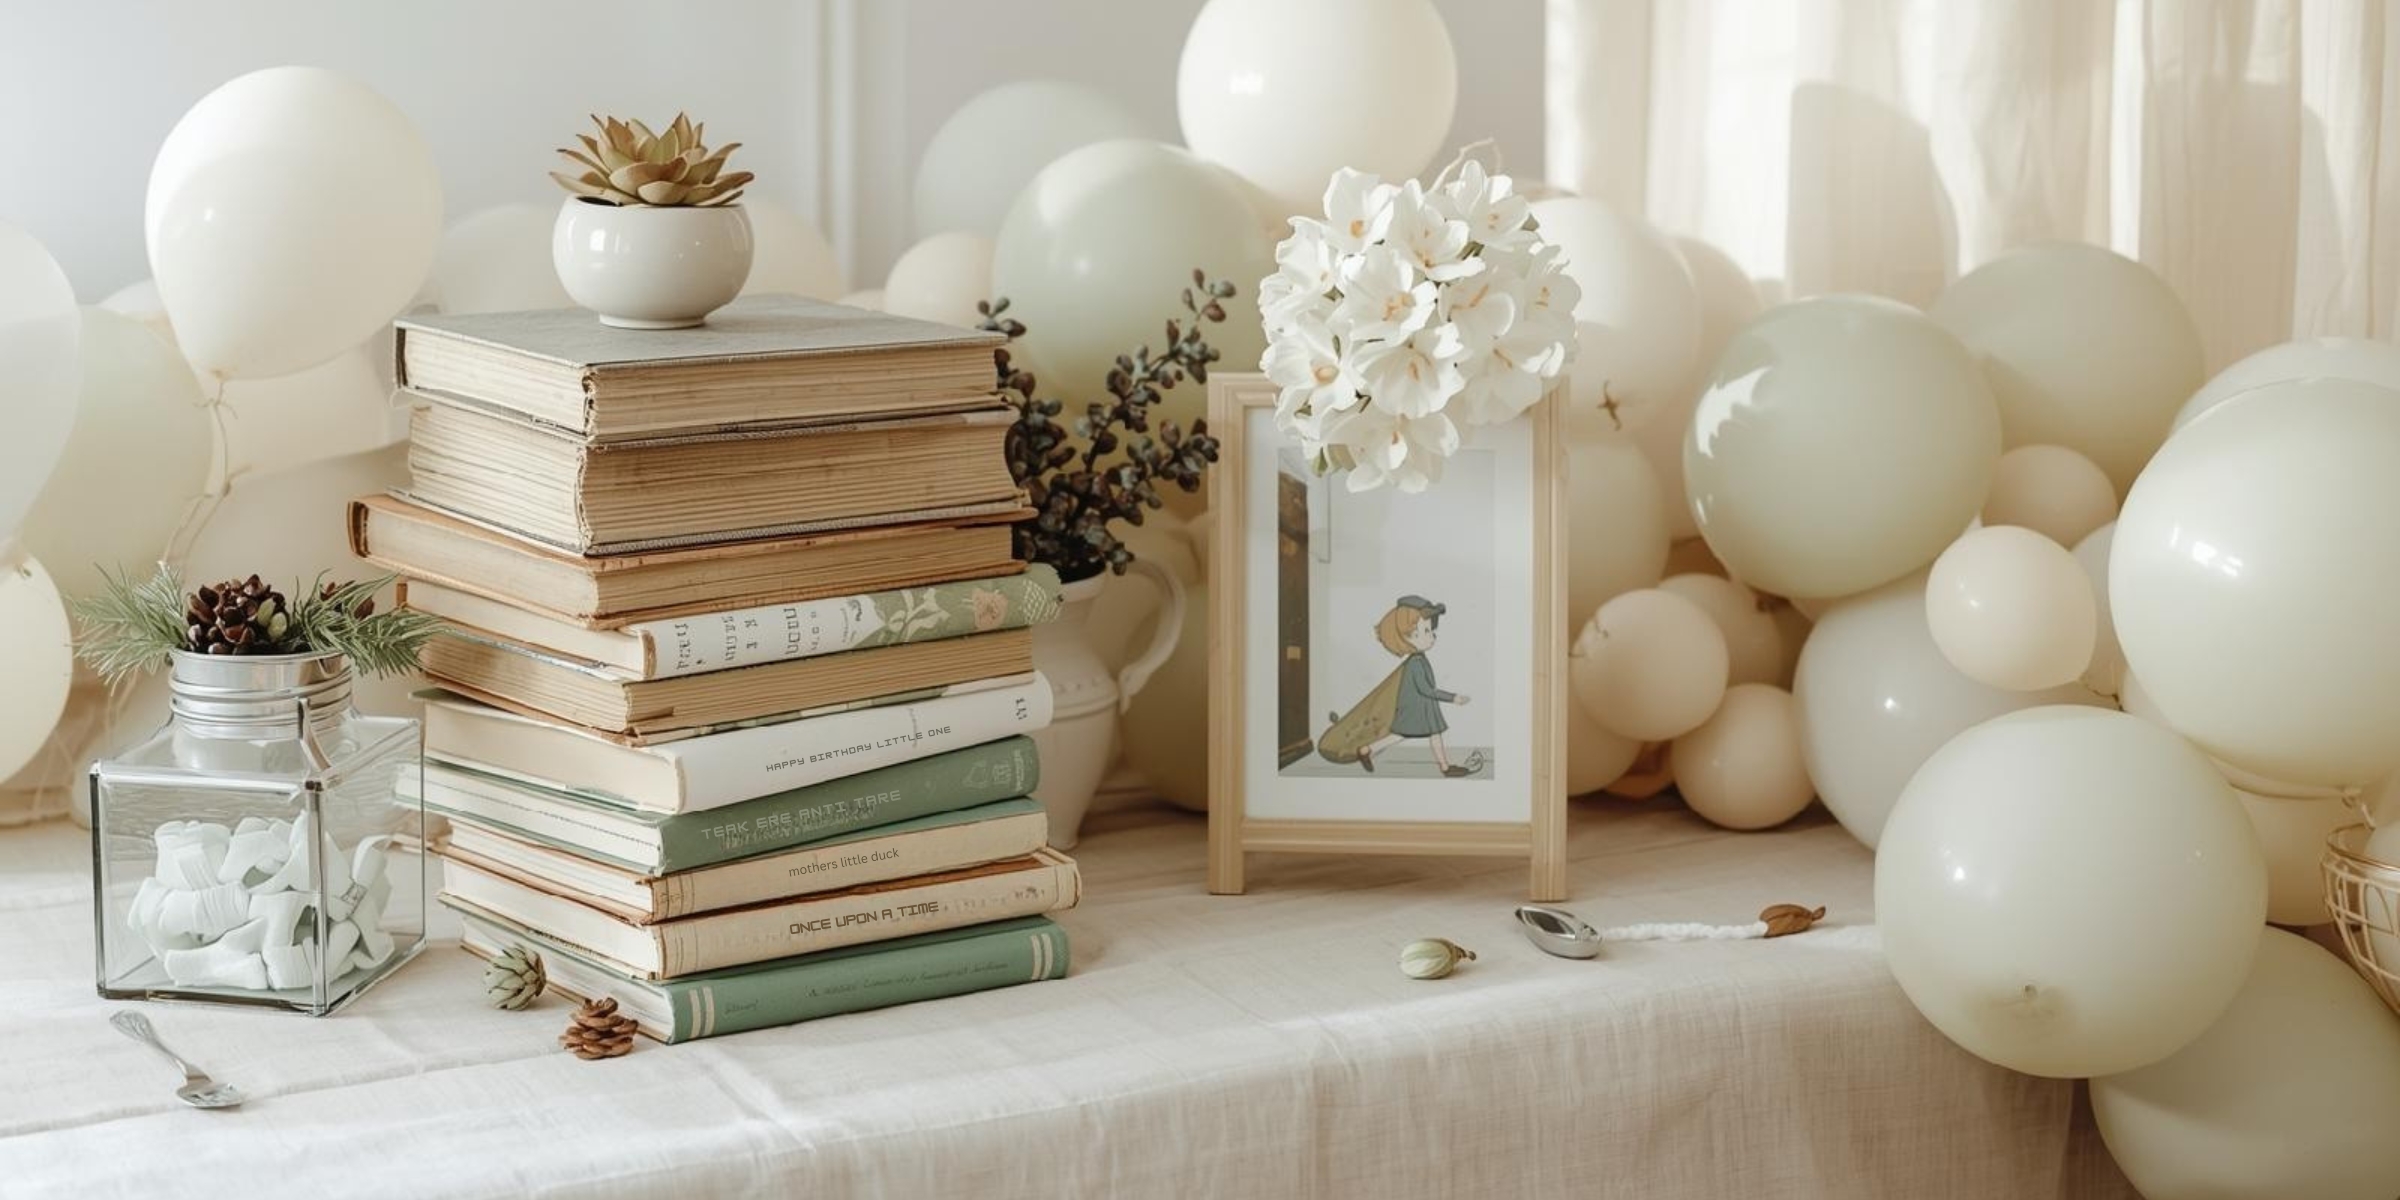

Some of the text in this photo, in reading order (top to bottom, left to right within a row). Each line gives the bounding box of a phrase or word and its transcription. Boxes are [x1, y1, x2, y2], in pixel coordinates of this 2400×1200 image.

[766, 725, 952, 772] HAPPY BIRTHDAY LITTLE ONE
[701, 821, 749, 840] TEAK
[756, 812, 792, 830] ERE
[799, 801, 846, 819] ANTI
[853, 790, 902, 808] TARE
[788, 848, 900, 877] mothers little duck
[789, 918, 832, 935] ONCE
[835, 910, 878, 928] UPON
[881, 908, 893, 920] A
[896, 901, 939, 918] TIME
